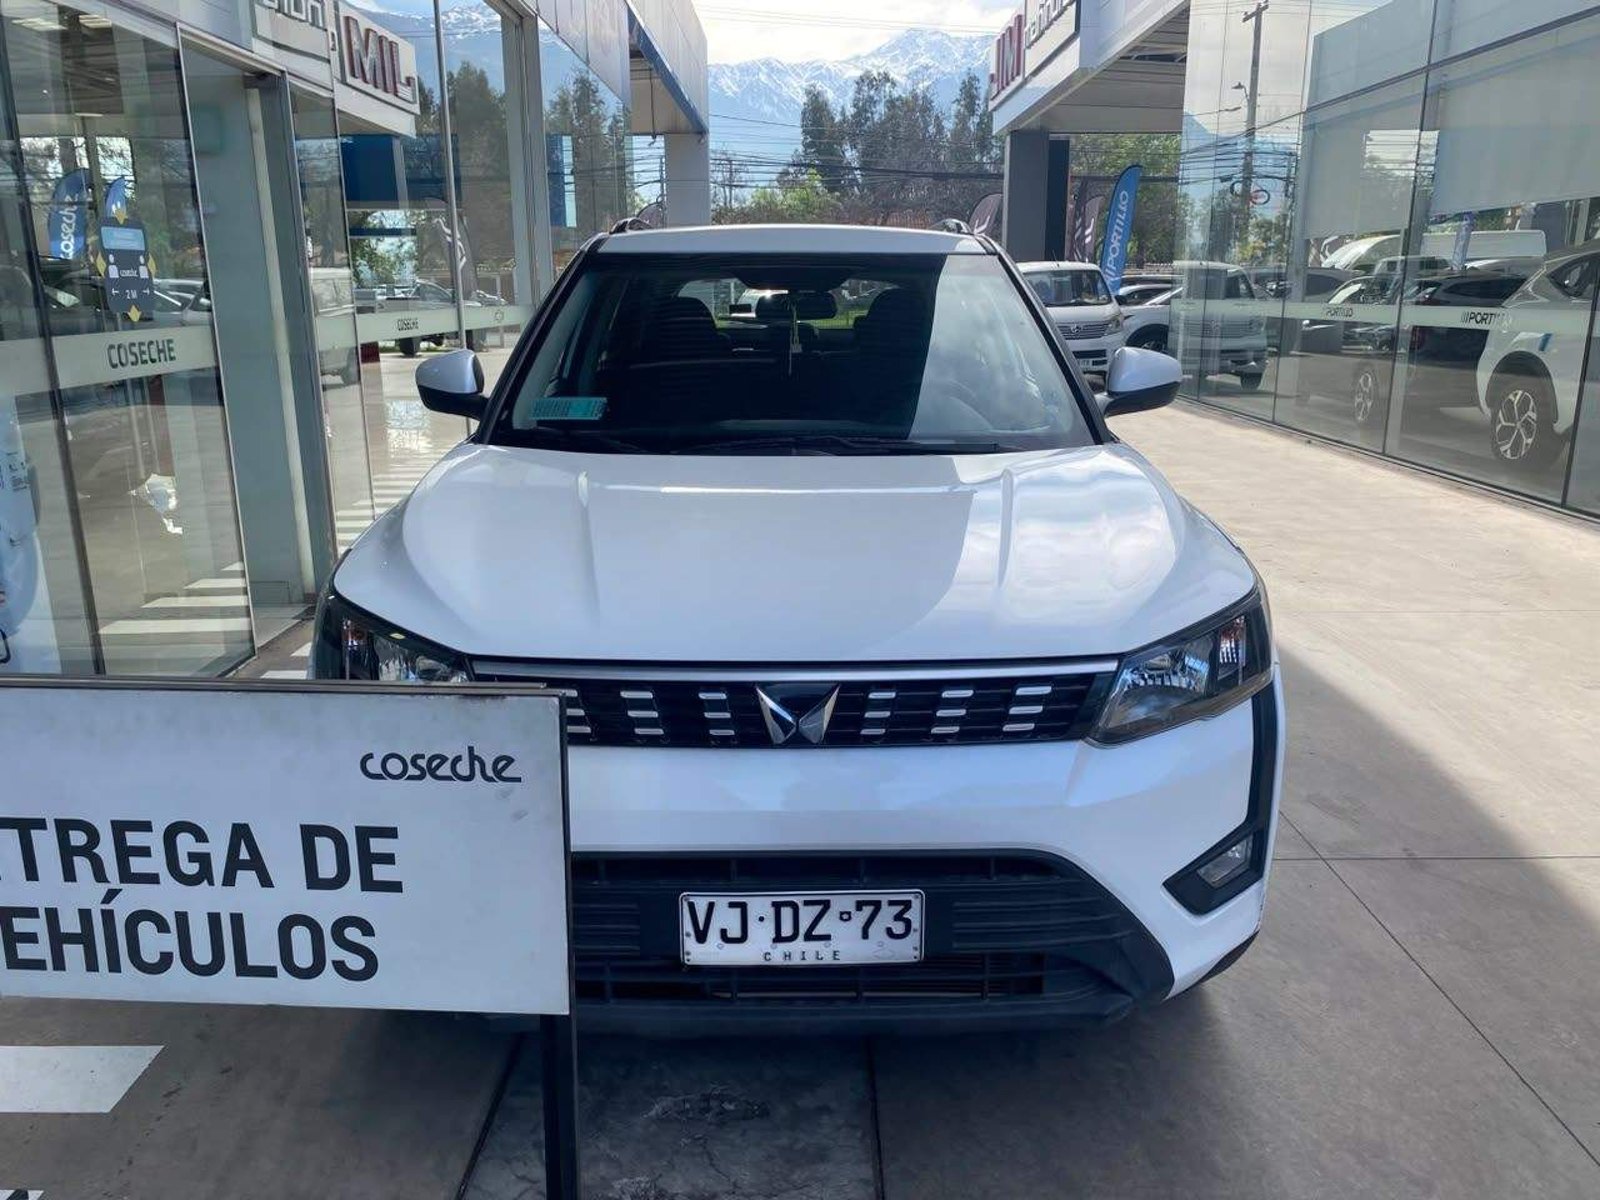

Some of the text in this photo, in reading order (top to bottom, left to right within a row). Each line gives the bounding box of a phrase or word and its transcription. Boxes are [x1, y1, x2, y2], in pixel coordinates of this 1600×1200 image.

[107, 338, 177, 369] COSECHE
[360, 746, 522, 783] coseche
[0, 817, 403, 893] TREGA DE
[763, 950, 841, 962] CHILE
